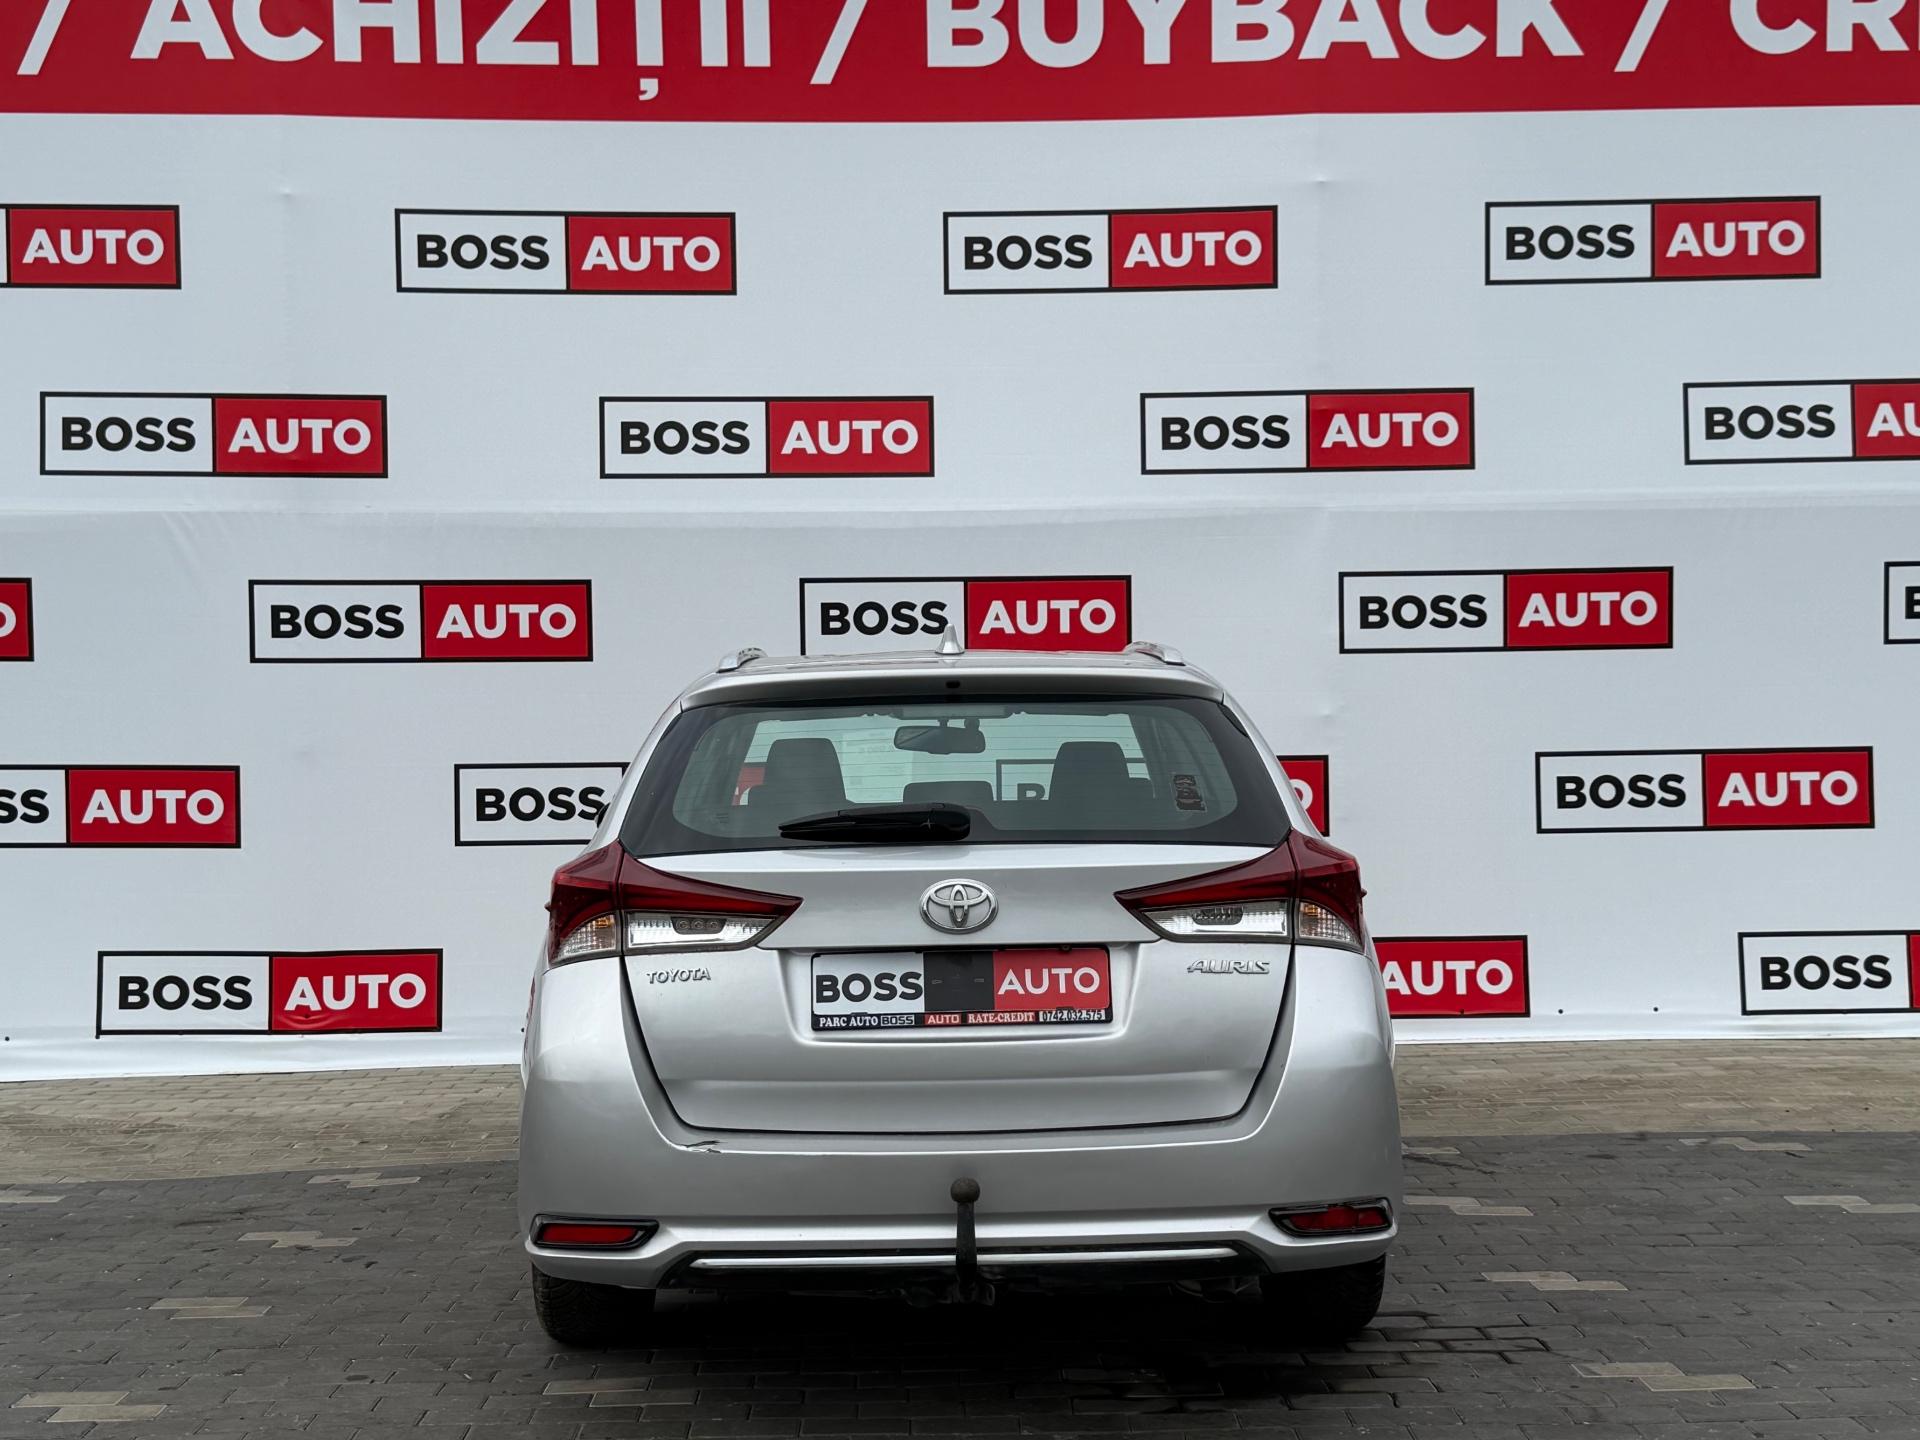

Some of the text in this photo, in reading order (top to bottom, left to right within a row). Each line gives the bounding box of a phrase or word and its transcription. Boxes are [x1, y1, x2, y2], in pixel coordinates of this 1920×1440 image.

[927, 0, 1584, 68] BUYBACK
[1730, 0, 1920, 55] CR
[23, 229, 164, 264] AUTO
[417, 234, 720, 271] BOSS AUTO
[965, 231, 1261, 270] BOSS AUTO
[1506, 221, 1804, 260] BOSS AUTO
[62, 417, 370, 454] BOSS AUTO
[621, 420, 918, 454] BOSS AUTO
[1162, 412, 1458, 450] BOSS AUTO
[1705, 405, 1835, 440] BOSS
[271, 604, 576, 639] BOSS AUTO
[821, 599, 1115, 635] BOSS AUTO
[1360, 591, 1657, 629] BOSS AUTO
[82, 790, 224, 824] AUTO
[476, 787, 605, 821] BOSS
[1557, 771, 1857, 809] BOSS AUTO
[646, 968, 711, 984] TOYOTA
[1187, 959, 1270, 974] AURIS
[1382, 960, 1514, 994] AUTO
[1761, 955, 1891, 990] BOSS
[119, 973, 426, 1010] BOSS AUTO
[816, 967, 1100, 1003] BOSS AUTO
[819, 1017, 847, 1027] PARC
[849, 1016, 878, 1027] AUTO
[881, 1015, 914, 1026] BOSS
[927, 1014, 960, 1024] AUTO
[968, 1013, 1035, 1023] RATE-CREDIT
